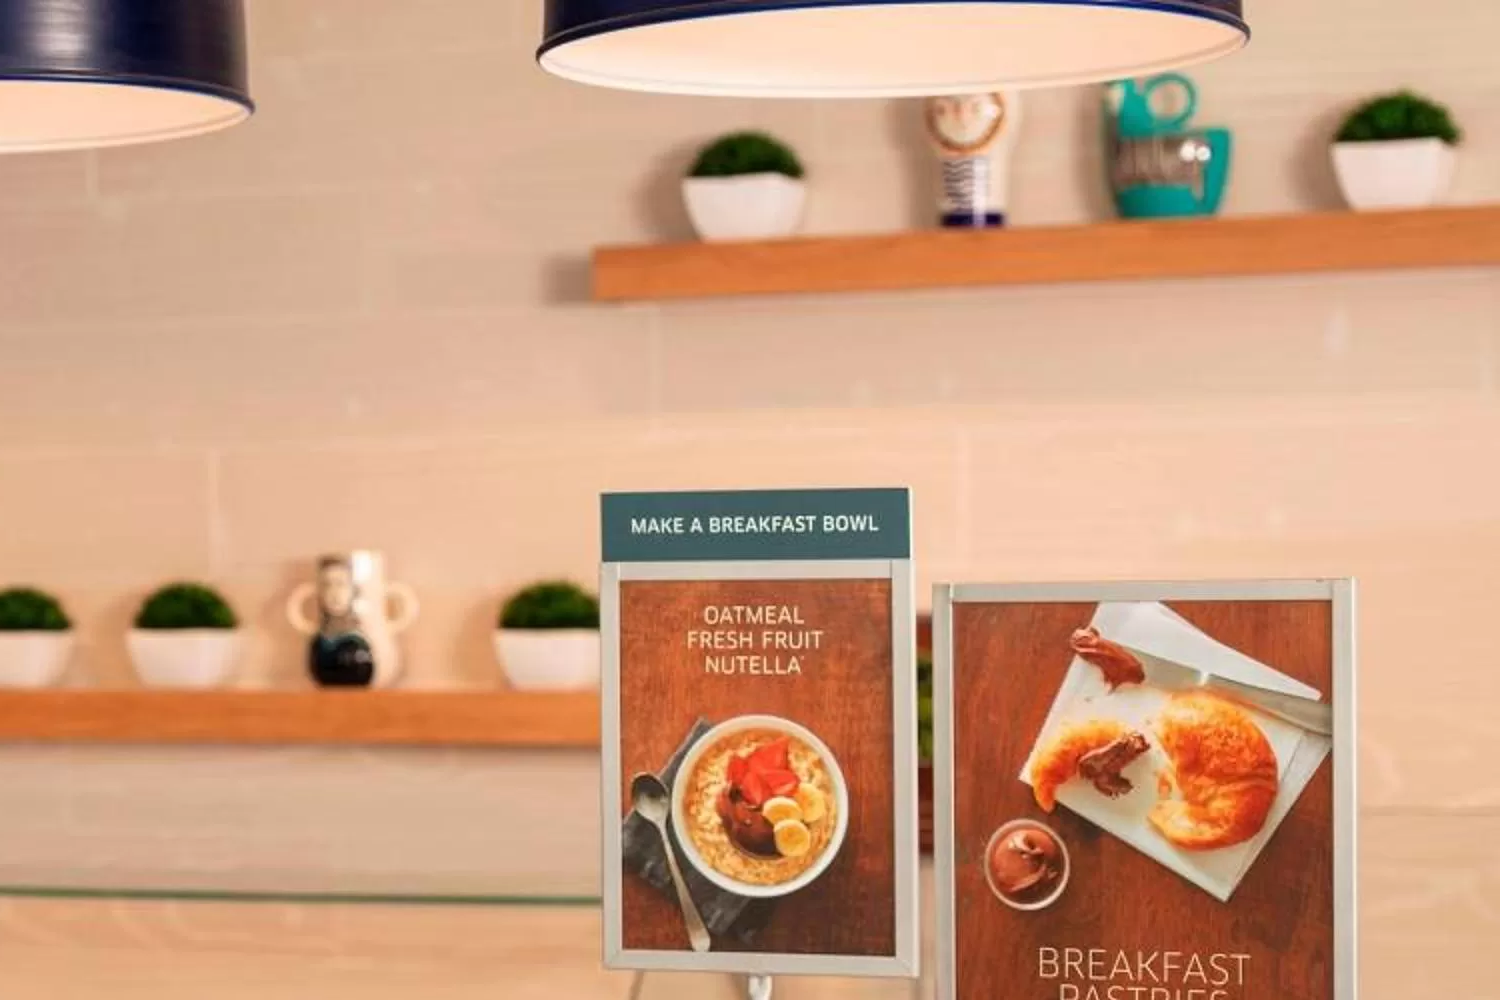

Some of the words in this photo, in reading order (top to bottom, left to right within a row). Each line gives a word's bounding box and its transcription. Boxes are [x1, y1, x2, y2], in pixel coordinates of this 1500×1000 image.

[631, 516, 685, 534] MAKE
[689, 516, 704, 534] A
[709, 515, 817, 533] BREAKFAST
[823, 514, 879, 532] BOWL
[703, 605, 805, 625] OATMEAL
[687, 630, 753, 650] FRESH
[762, 630, 823, 649] FRUIT
[1037, 947, 1252, 986] BREAKFAST
